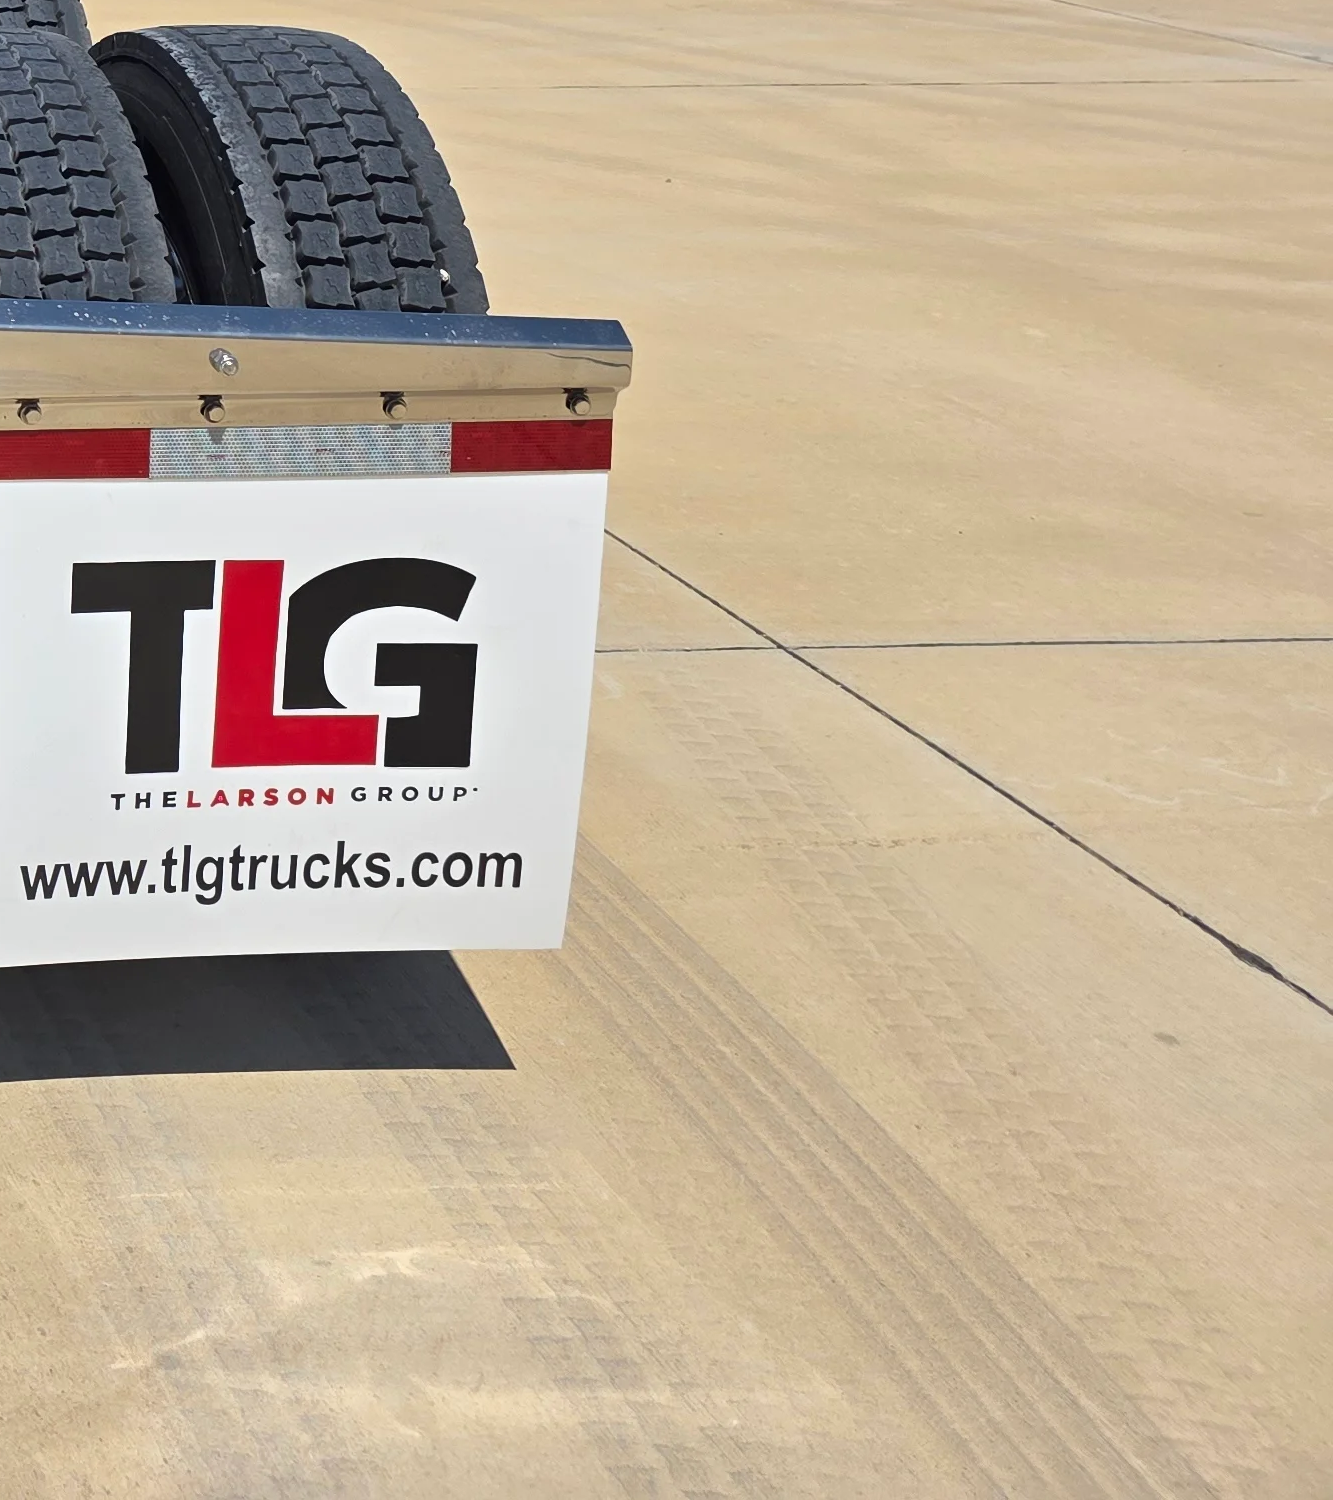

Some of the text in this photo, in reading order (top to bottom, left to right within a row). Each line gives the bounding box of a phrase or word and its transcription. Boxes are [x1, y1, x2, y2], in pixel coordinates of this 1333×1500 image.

[70, 557, 479, 776] TLG
[350, 785, 469, 803] GROUP
[19, 840, 523, 906] www.tlgtrucks.com
